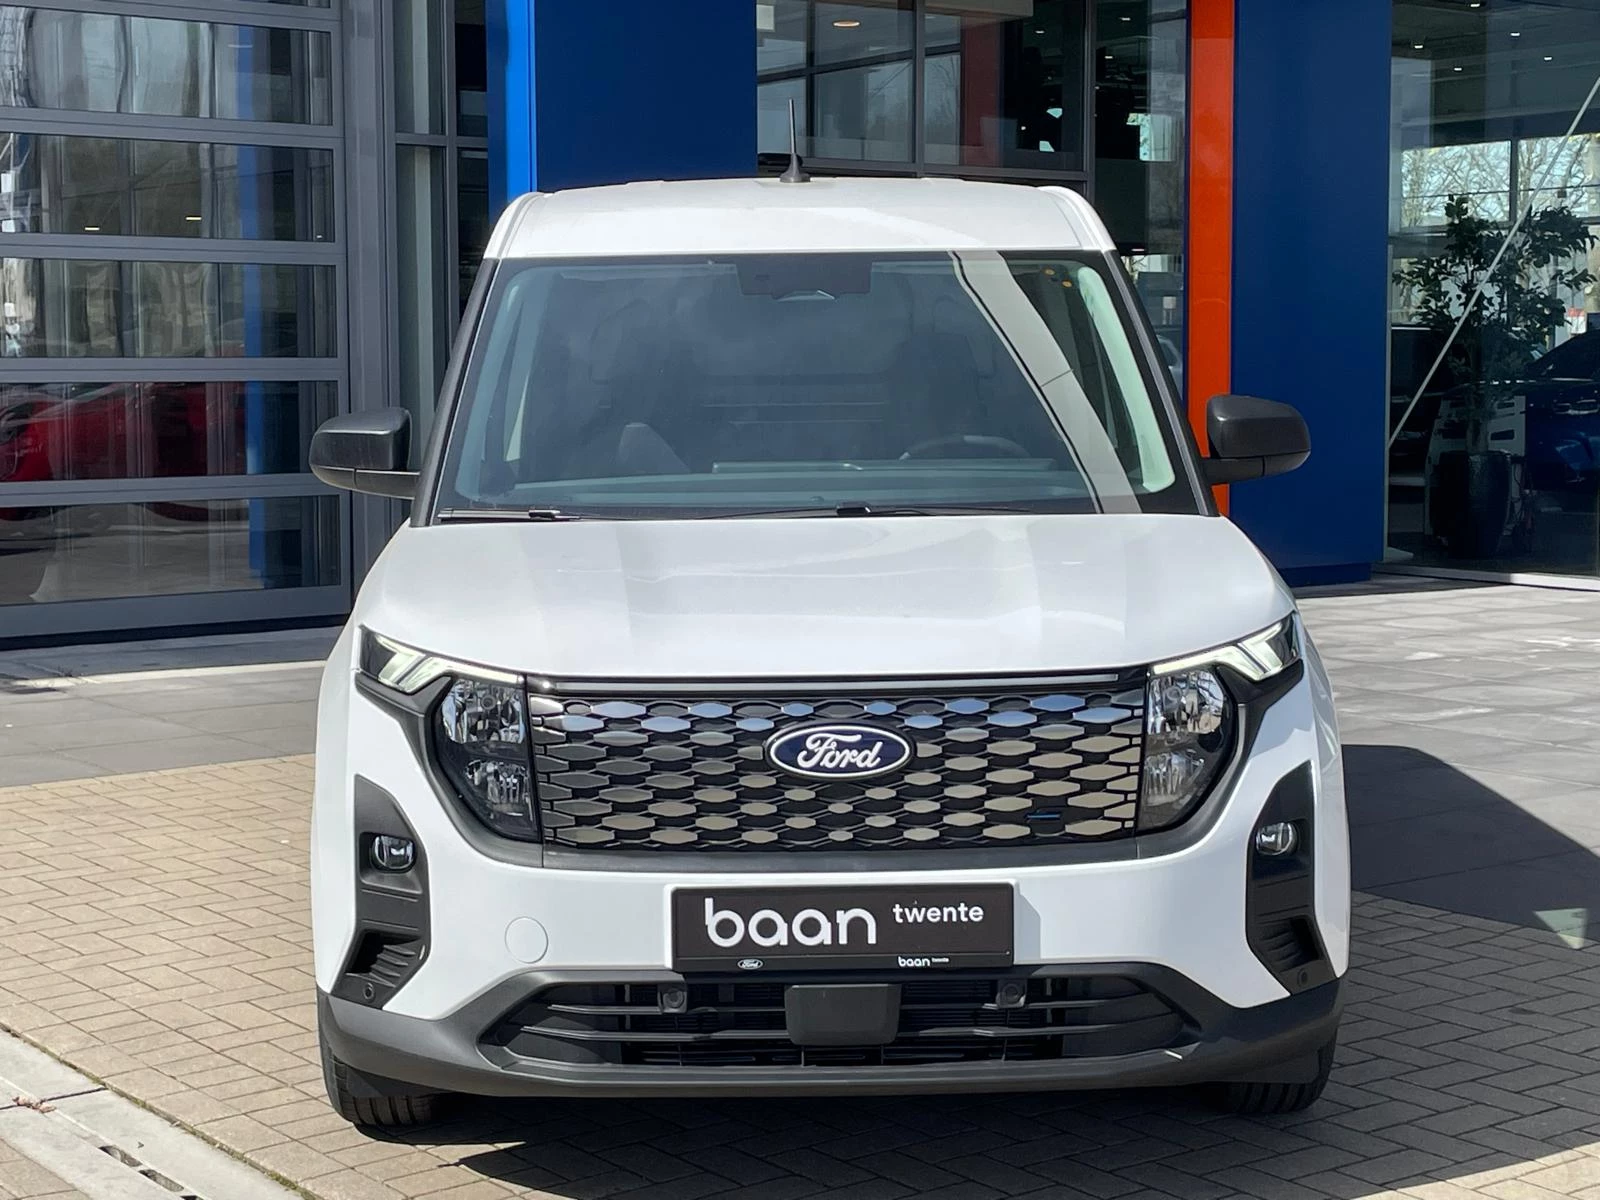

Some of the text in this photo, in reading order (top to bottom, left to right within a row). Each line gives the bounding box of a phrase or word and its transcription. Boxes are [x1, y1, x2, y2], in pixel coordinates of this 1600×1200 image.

[797, 733, 883, 768] Ford
[705, 897, 985, 947] baan twente
[898, 955, 930, 967] baan
